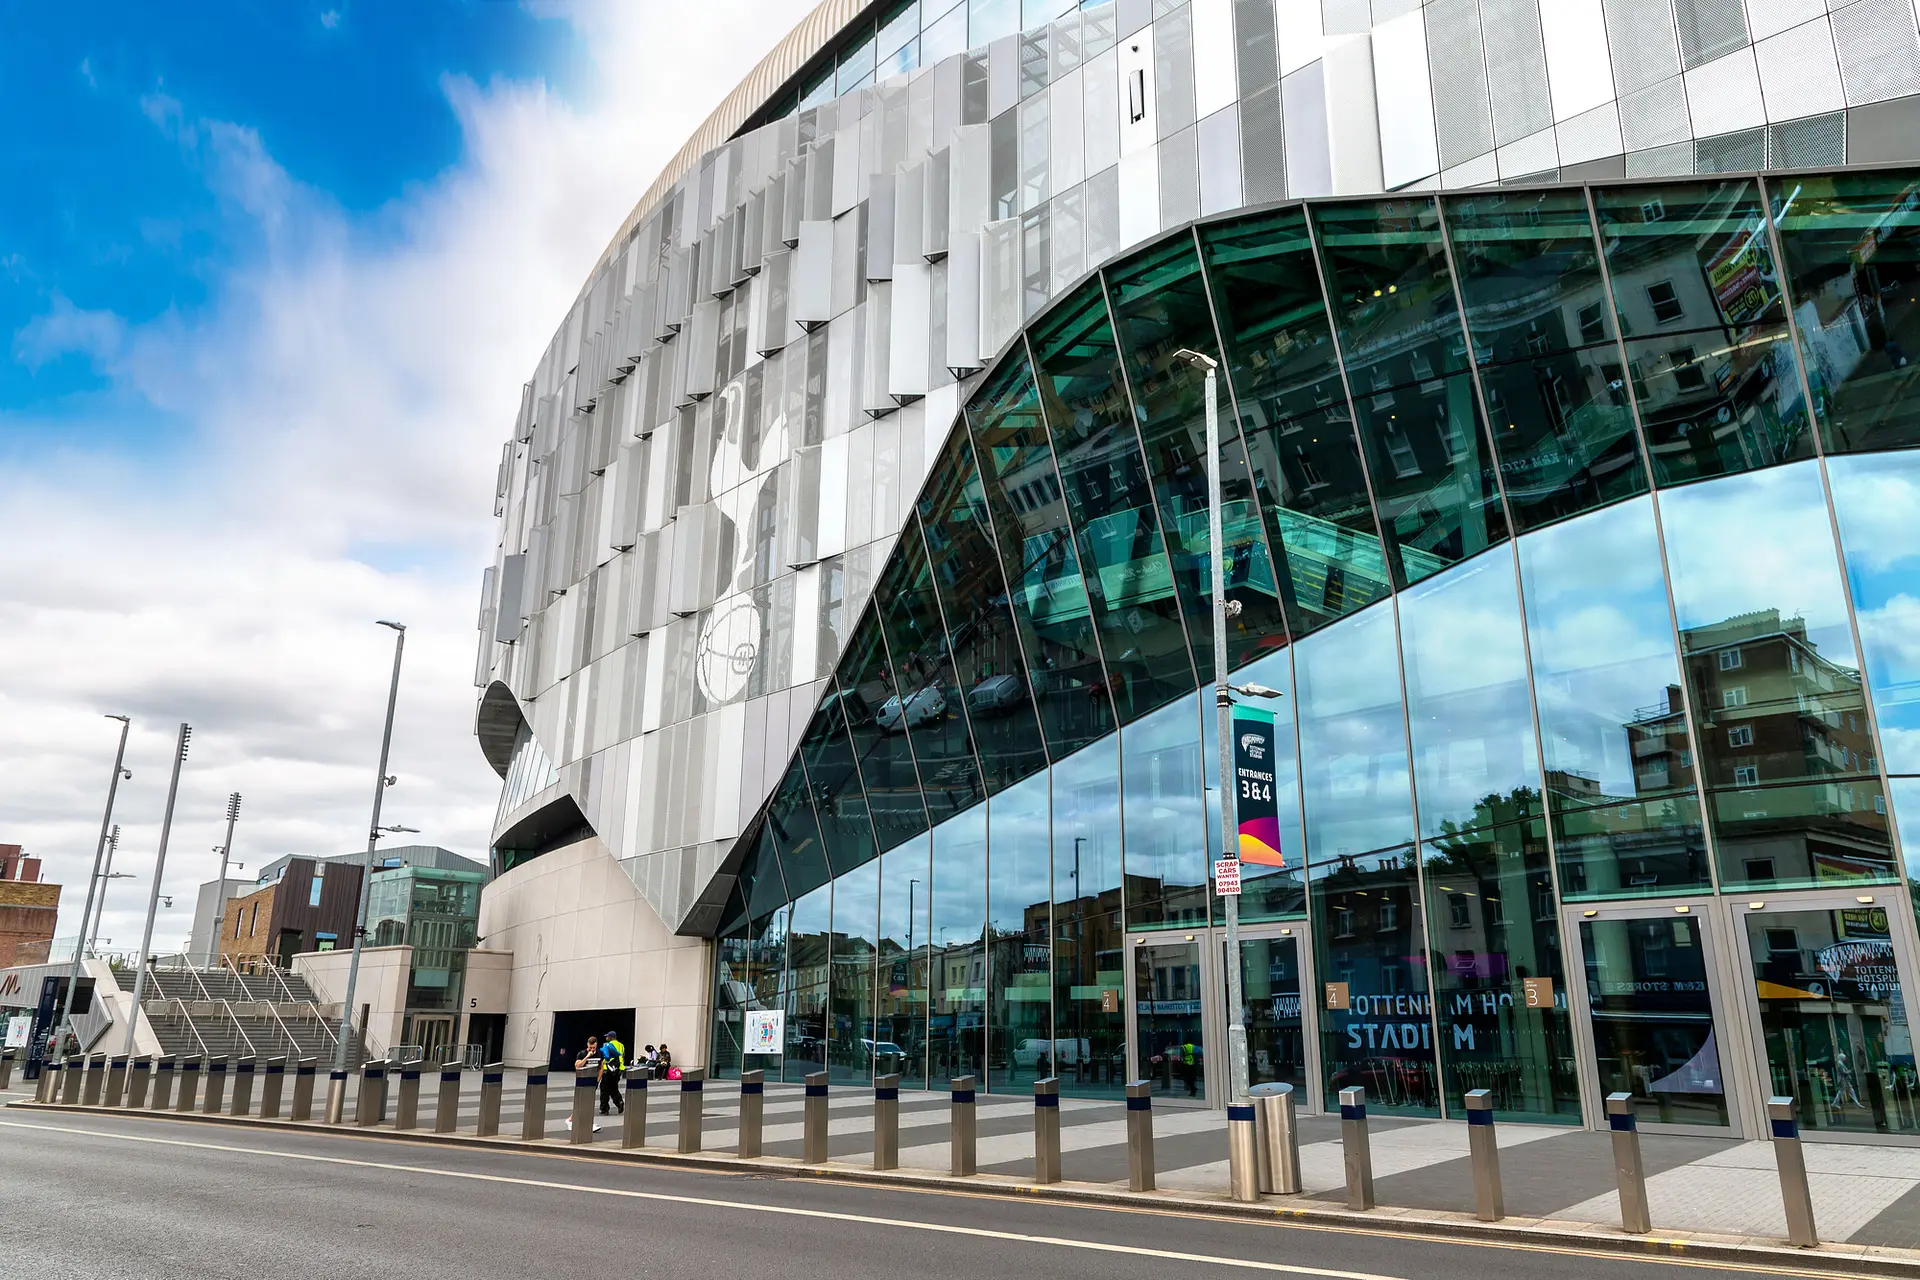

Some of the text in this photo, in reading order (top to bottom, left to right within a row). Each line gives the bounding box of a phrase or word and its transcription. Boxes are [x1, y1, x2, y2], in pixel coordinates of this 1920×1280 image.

[1238, 767, 1273, 782] ENTRANCES
[1241, 780, 1271, 802] 3&4
[1854, 965, 1898, 975] TOTTENH
[1855, 974, 1899, 983] HOTSPU
[1857, 982, 1901, 992] STADIU
[470, 998, 477, 1008] 5
[1329, 992, 1337, 1007] 4
[1526, 988, 1538, 1006] 3
[1346, 1023, 1476, 1050] STADIM
